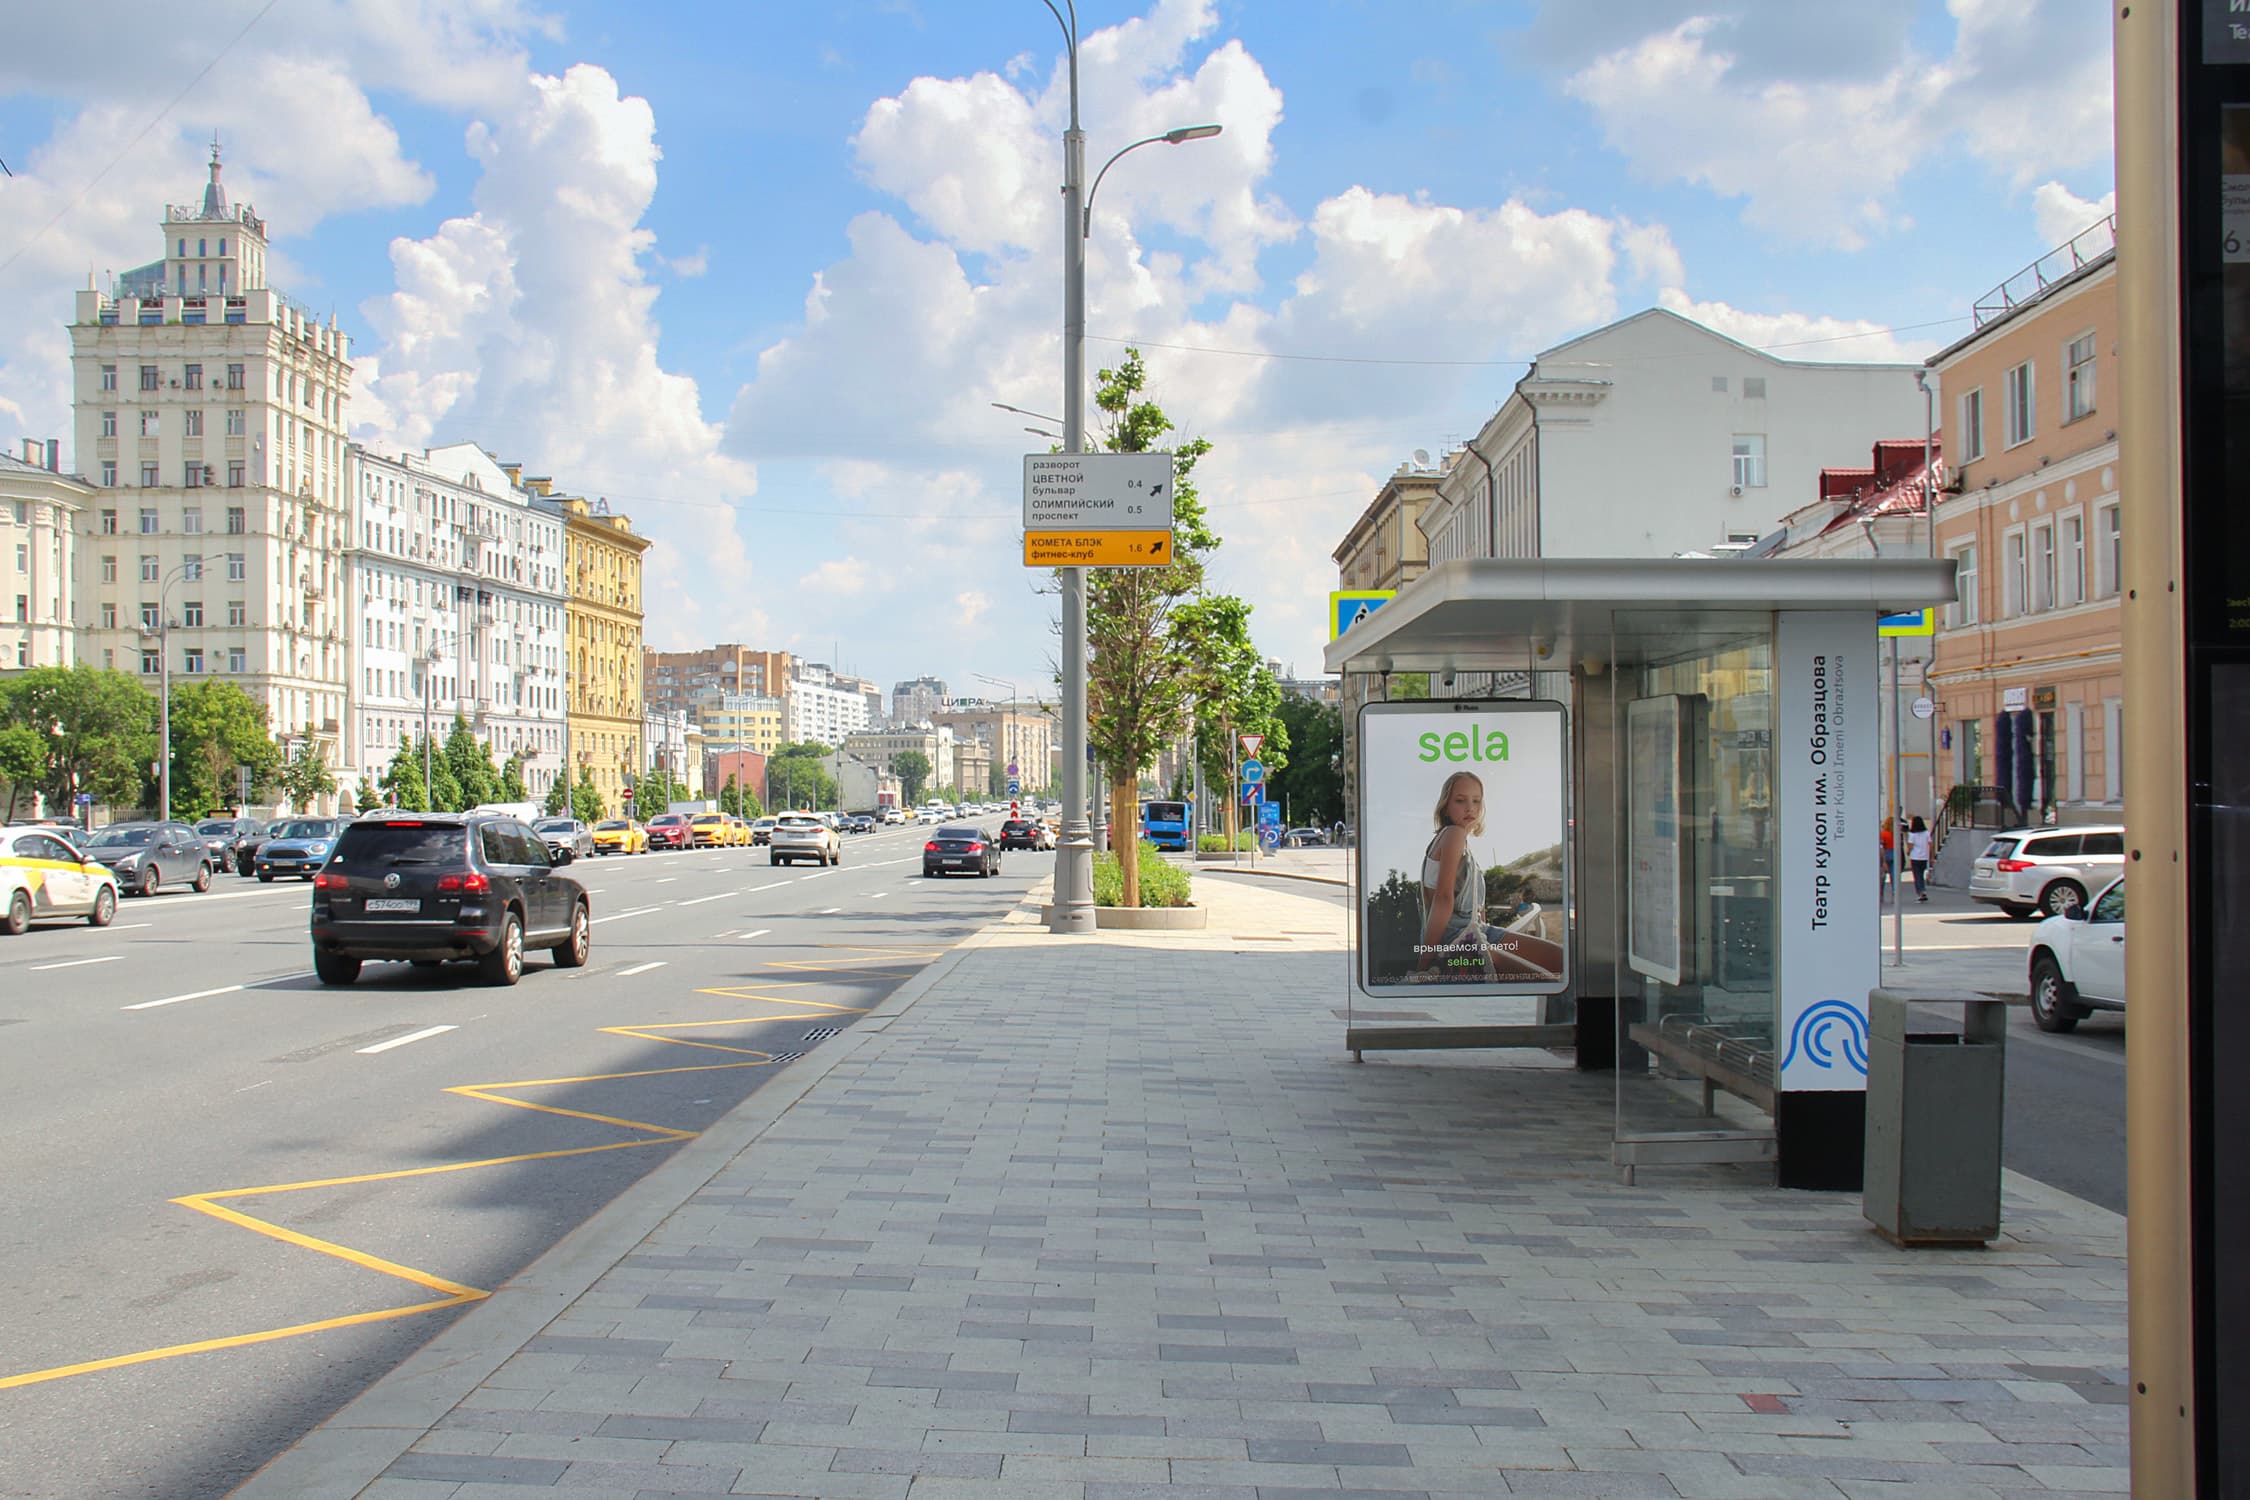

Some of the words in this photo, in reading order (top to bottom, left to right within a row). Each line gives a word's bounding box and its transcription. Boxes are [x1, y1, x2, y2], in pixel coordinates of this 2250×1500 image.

[1033, 462, 1080, 470] разворот
[1033, 473, 1084, 483] ЦВЕТНОЙ
[1128, 480, 1143, 488] 0.4
[1032, 486, 1076, 496] бульвар
[1032, 498, 1114, 509] ОЛИМПИЙСКИЙ
[1127, 506, 1143, 514] 0.5
[1032, 512, 1079, 521] проспект
[1031, 538, 1072, 547] КОМЕТА
[1075, 538, 1103, 547] БЛЭК
[1128, 544, 1143, 553] 1.6
[1031, 550, 1094, 560] фитнес-клуб
[1832, 655, 1845, 726] Obraztsova
[1810, 655, 1830, 765] Образцова
[1418, 723, 1510, 763] sela
[1833, 730, 1845, 767] Imeni
[1815, 772, 1827, 805] им.
[1833, 771, 1845, 805] Kukol
[1833, 810, 1845, 840] Teatr
[1815, 813, 1831, 868] кукол
[1812, 875, 1831, 931] Театр
[1413, 943, 1478, 955] врываемся
[1480, 943, 1487, 951] в
[1490, 940, 1519, 951] лето!
[1447, 956, 1485, 967] sela.ru
